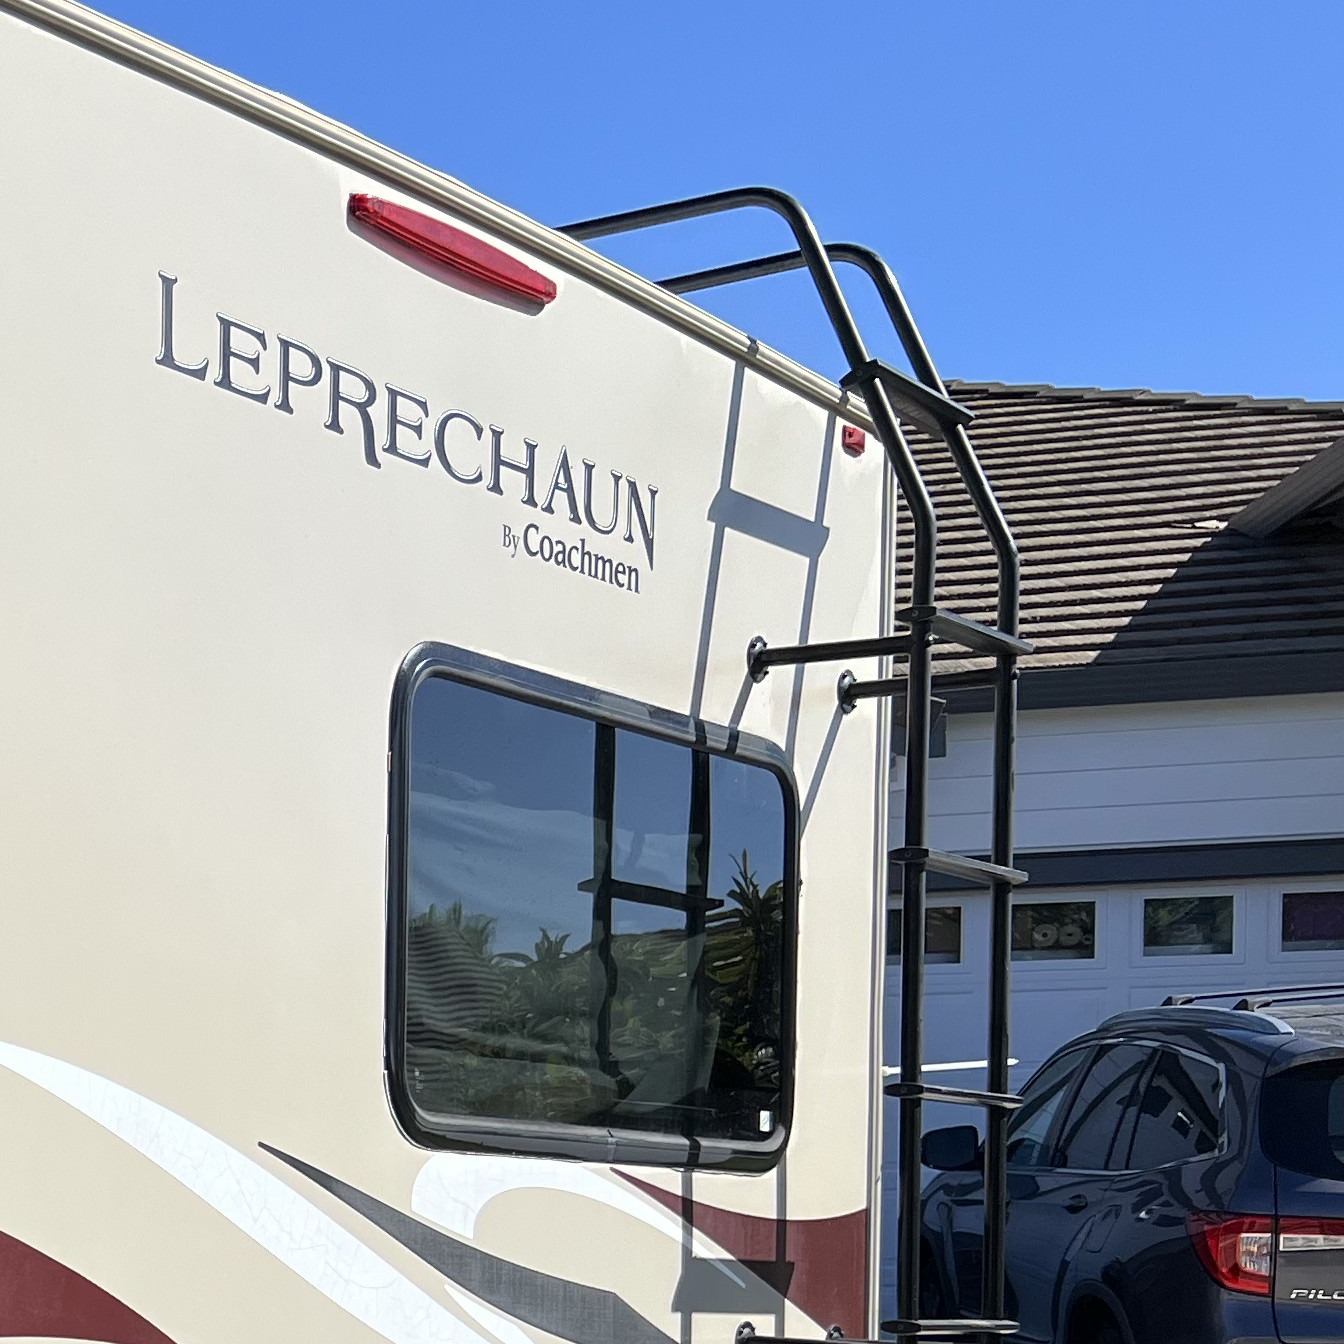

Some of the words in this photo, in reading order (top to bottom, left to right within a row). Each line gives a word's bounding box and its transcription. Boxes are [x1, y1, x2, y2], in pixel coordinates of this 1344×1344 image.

[154, 270, 659, 572] LEPRECHAUN
[502, 523, 521, 558] By
[523, 522, 641, 595] Coachmen
